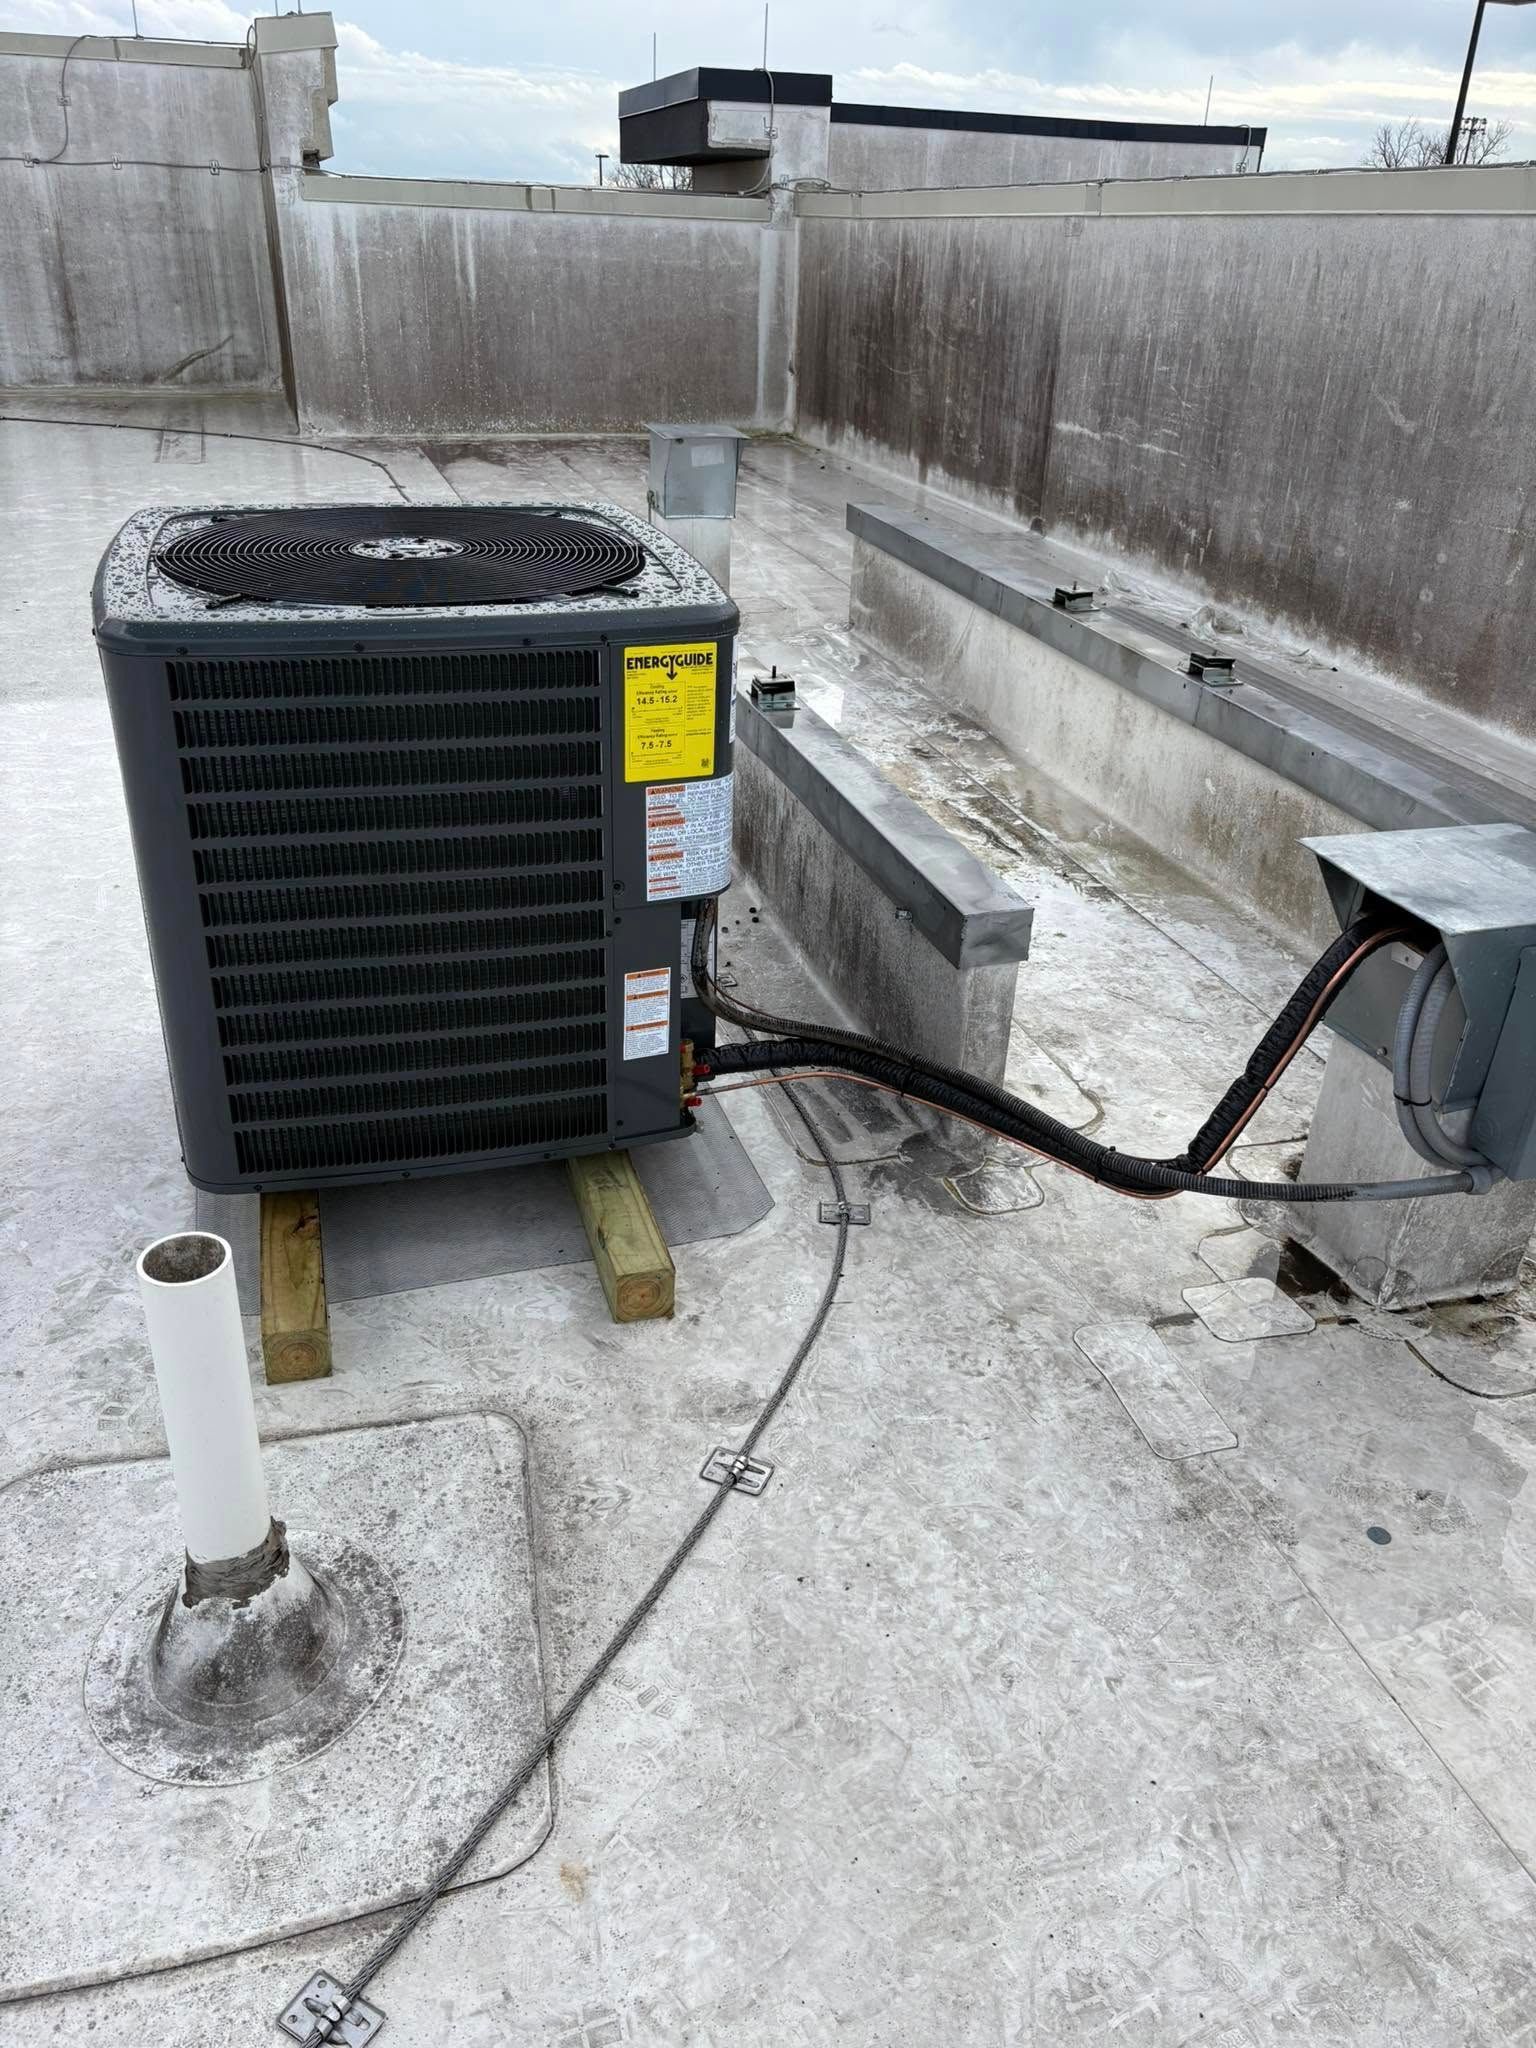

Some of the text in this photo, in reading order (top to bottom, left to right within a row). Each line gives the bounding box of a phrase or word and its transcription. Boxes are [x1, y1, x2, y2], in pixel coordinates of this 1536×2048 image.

[627, 653, 713, 672] ENERGYGUIDE
[637, 697, 654, 705] 14.5
[660, 695, 678, 703] 15.2
[641, 742, 654, 750] 7.5
[660, 740, 672, 748] 7.5
